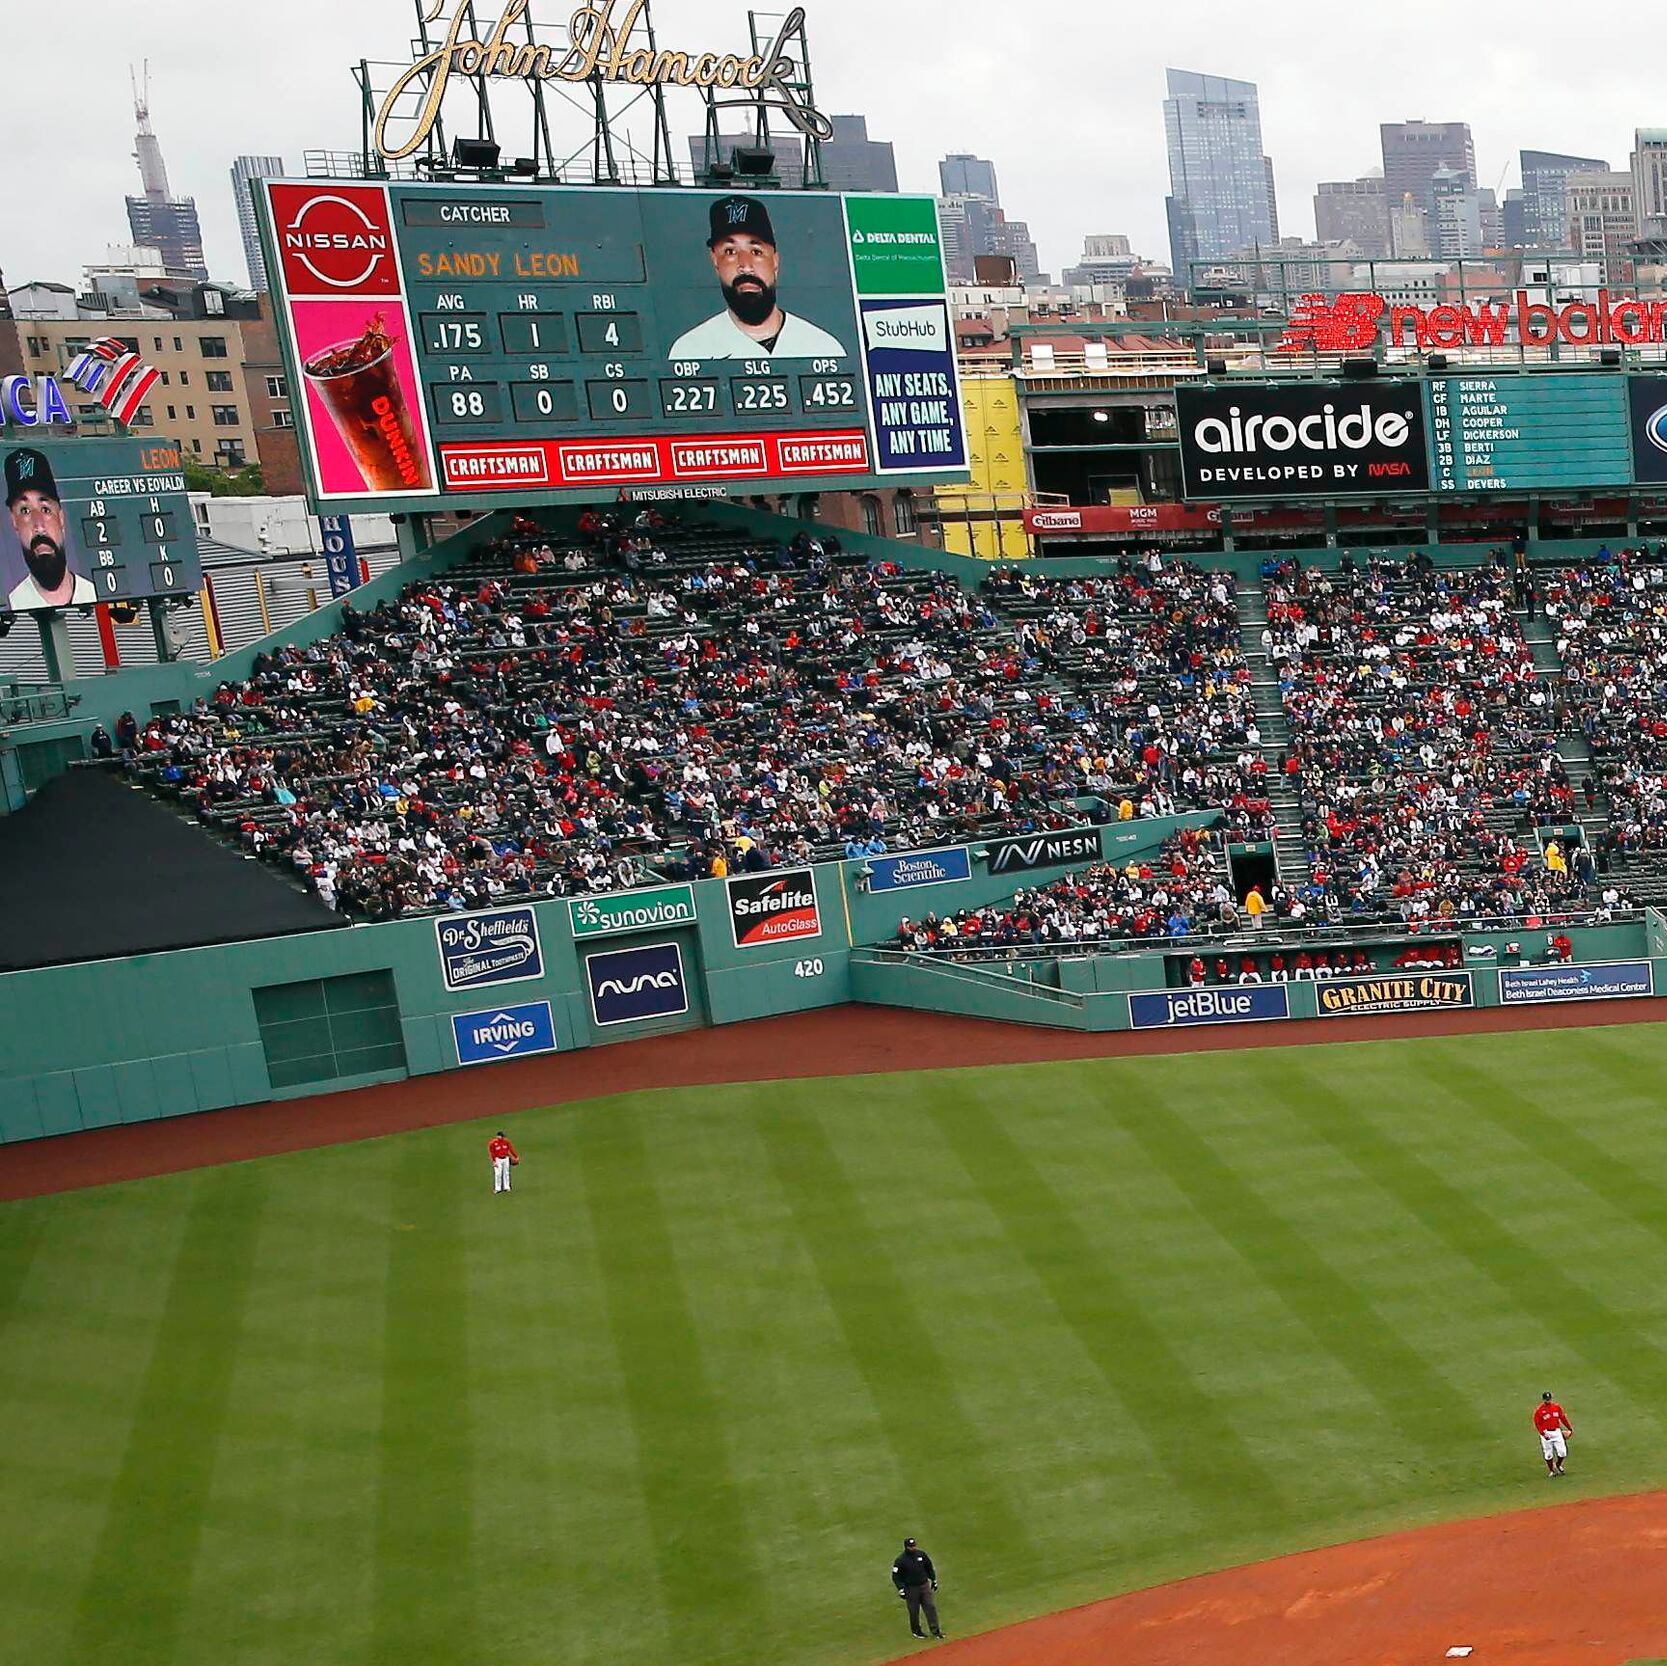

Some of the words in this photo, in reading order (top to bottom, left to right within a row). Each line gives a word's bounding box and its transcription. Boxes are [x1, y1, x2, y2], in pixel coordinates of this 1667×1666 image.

[375, 0, 556, 160] John
[545, 0, 834, 141] Hancock
[440, 205, 511, 223] CATCHER
[286, 233, 386, 249] NISSAN
[866, 233, 896, 245] DELTA
[897, 233, 936, 245] DENTAL
[418, 253, 501, 276] SANDY
[515, 253, 580, 277] LEON
[436, 294, 465, 309] AVG
[518, 295, 538, 309] HR
[592, 295, 616, 310] RBI
[433, 322, 483, 349] .175
[531, 322, 538, 348] 1
[604, 322, 619, 348] 4
[876, 320, 937, 340] StubHub
[1390, 302, 1510, 348] new
[449, 366, 472, 381] PA
[528, 365, 550, 380] SB
[605, 363, 625, 379] CS
[673, 362, 701, 377] OBP
[744, 360, 771, 376] SLG
[812, 360, 838, 374] OPS
[876, 374, 903, 397] ANY
[904, 373, 953, 397] SEATS,
[1432, 381, 1446, 392] RF
[1459, 380, 1497, 392] SIERRA
[451, 392, 485, 416] 88
[536, 390, 553, 415] 0
[612, 389, 628, 413] 0
[666, 387, 716, 412] .227
[737, 385, 788, 409] .225
[805, 382, 853, 407] .452
[881, 404, 908, 426] ANY
[910, 403, 954, 428] GAME,
[1434, 418, 1450, 429] DH
[1462, 417, 1504, 428] COOPER
[1194, 403, 1409, 453] airocide
[1436, 430, 1451, 442] LF
[1463, 429, 1520, 441] DICKERSON
[889, 431, 914, 454] ANY
[916, 430, 952, 453] TIME
[141, 448, 181, 470] LEON
[449, 456, 540, 476] CRAFTSMAN
[566, 452, 653, 472] CRAFTSMAN
[678, 447, 760, 468] CRAFTSMAN
[784, 443, 863, 463] CRAFTSMAN
[1200, 465, 1324, 482] DEVELOPED
[1333, 464, 1359, 479] BY
[1368, 463, 1411, 477] NASA
[94, 478, 132, 495] CAREER
[132, 477, 146, 493] VS
[632, 488, 683, 501] MITSUBISHI
[684, 486, 727, 499] ELECTRIC
[1047, 836, 1098, 858] NESN
[892, 866, 946, 885] Scientific
[898, 860, 934, 875] Boston
[734, 891, 813, 916] Safelite
[600, 901, 689, 930] sunovion
[762, 916, 818, 936] AutoGlass
[464, 918, 530, 950] Sheffield's
[453, 958, 492, 981] ORIGINAL
[793, 958, 824, 979] 420
[597, 971, 678, 998] nuna
[1322, 981, 1416, 1010] GRANITE
[1418, 977, 1467, 1003] CITY
[1166, 991, 1250, 1023] jetBlue
[473, 1020, 535, 1046] IRVING
